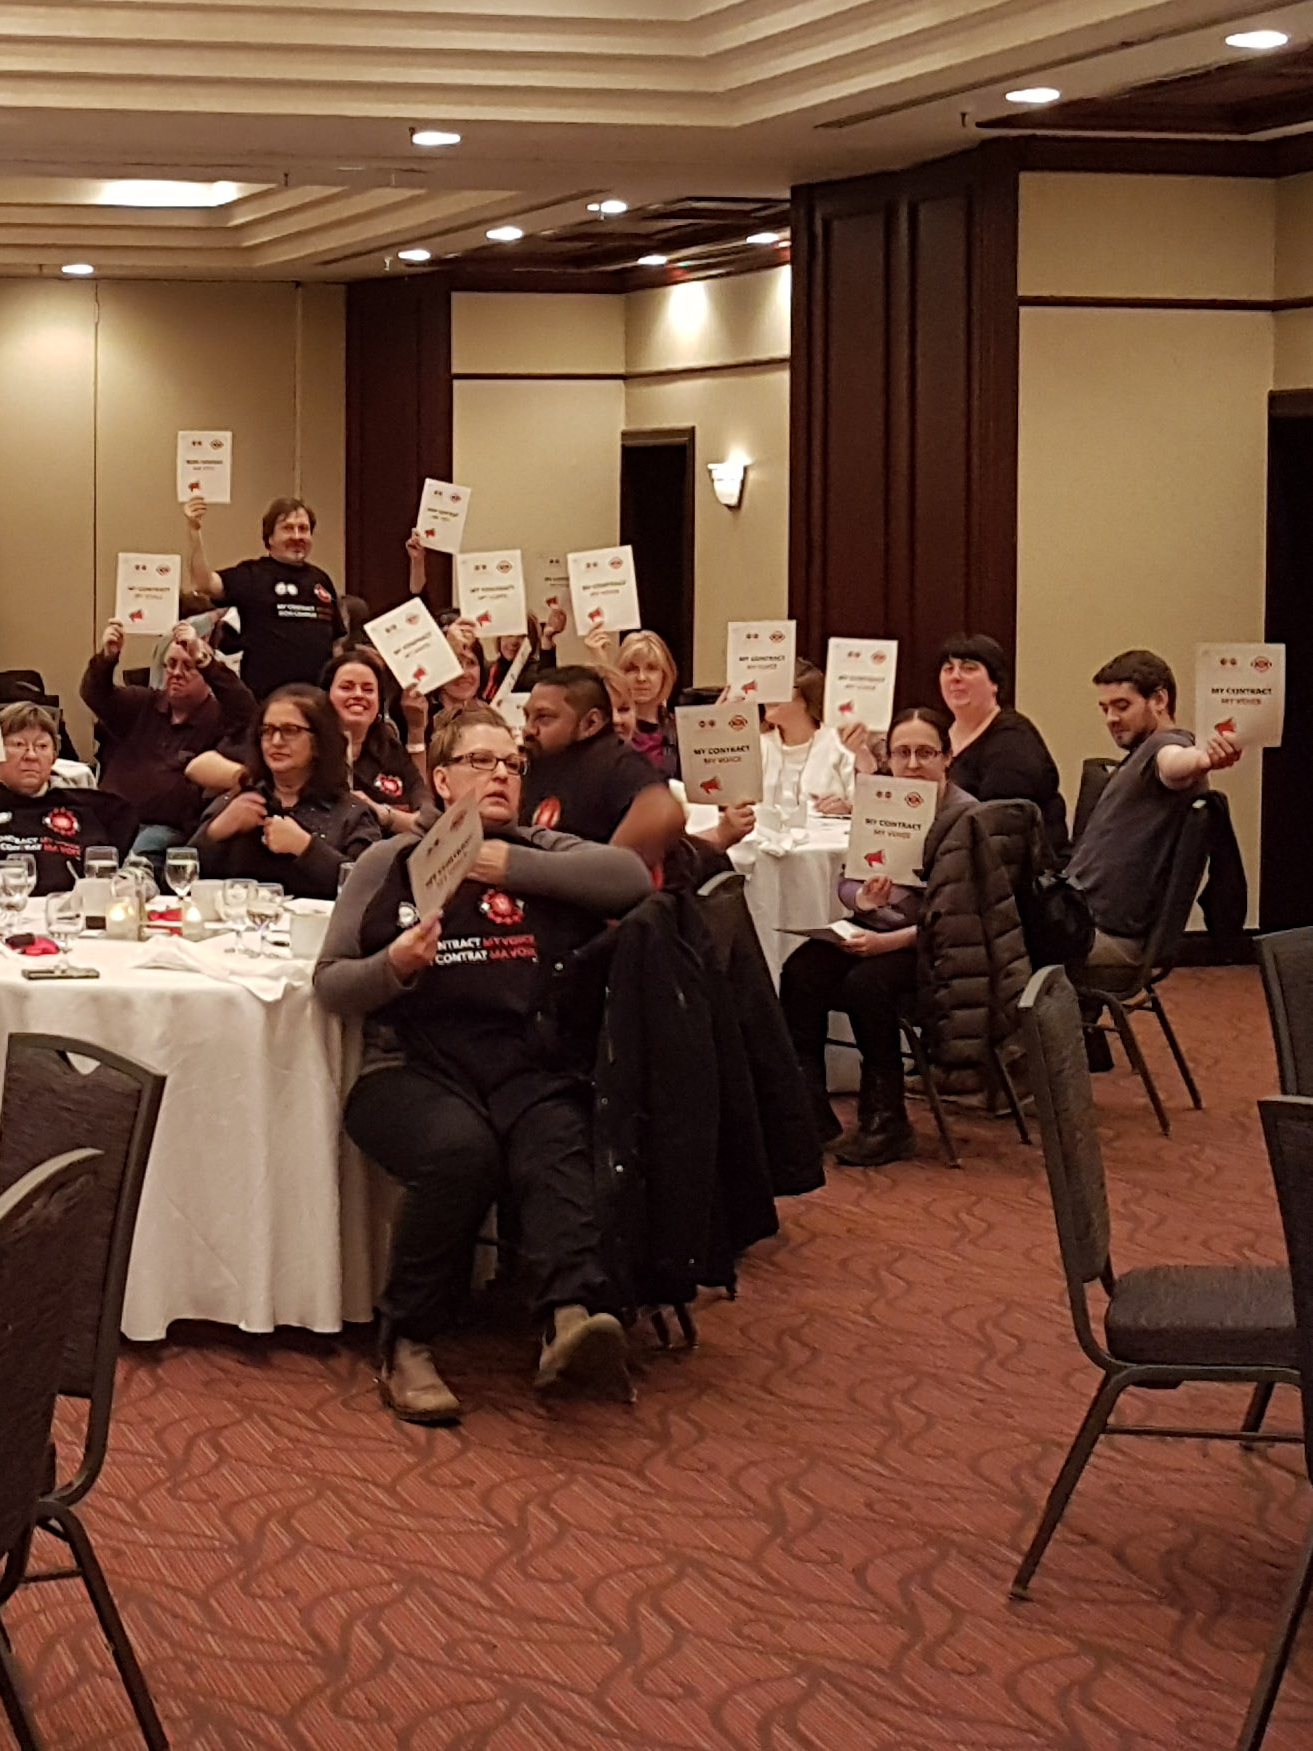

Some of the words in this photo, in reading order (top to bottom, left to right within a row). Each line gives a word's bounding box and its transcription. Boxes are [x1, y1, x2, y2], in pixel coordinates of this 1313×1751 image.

[1211, 687, 1225, 695] MY
[1226, 687, 1273, 696] CONTRACT
[693, 748, 706, 756] MY
[707, 744, 751, 756] CONTRACT
[864, 817, 878, 825] MY
[878, 819, 923, 831] CONTRACT
[437, 936, 482, 951] NTRACT
[434, 949, 489, 966] CONTRAT
